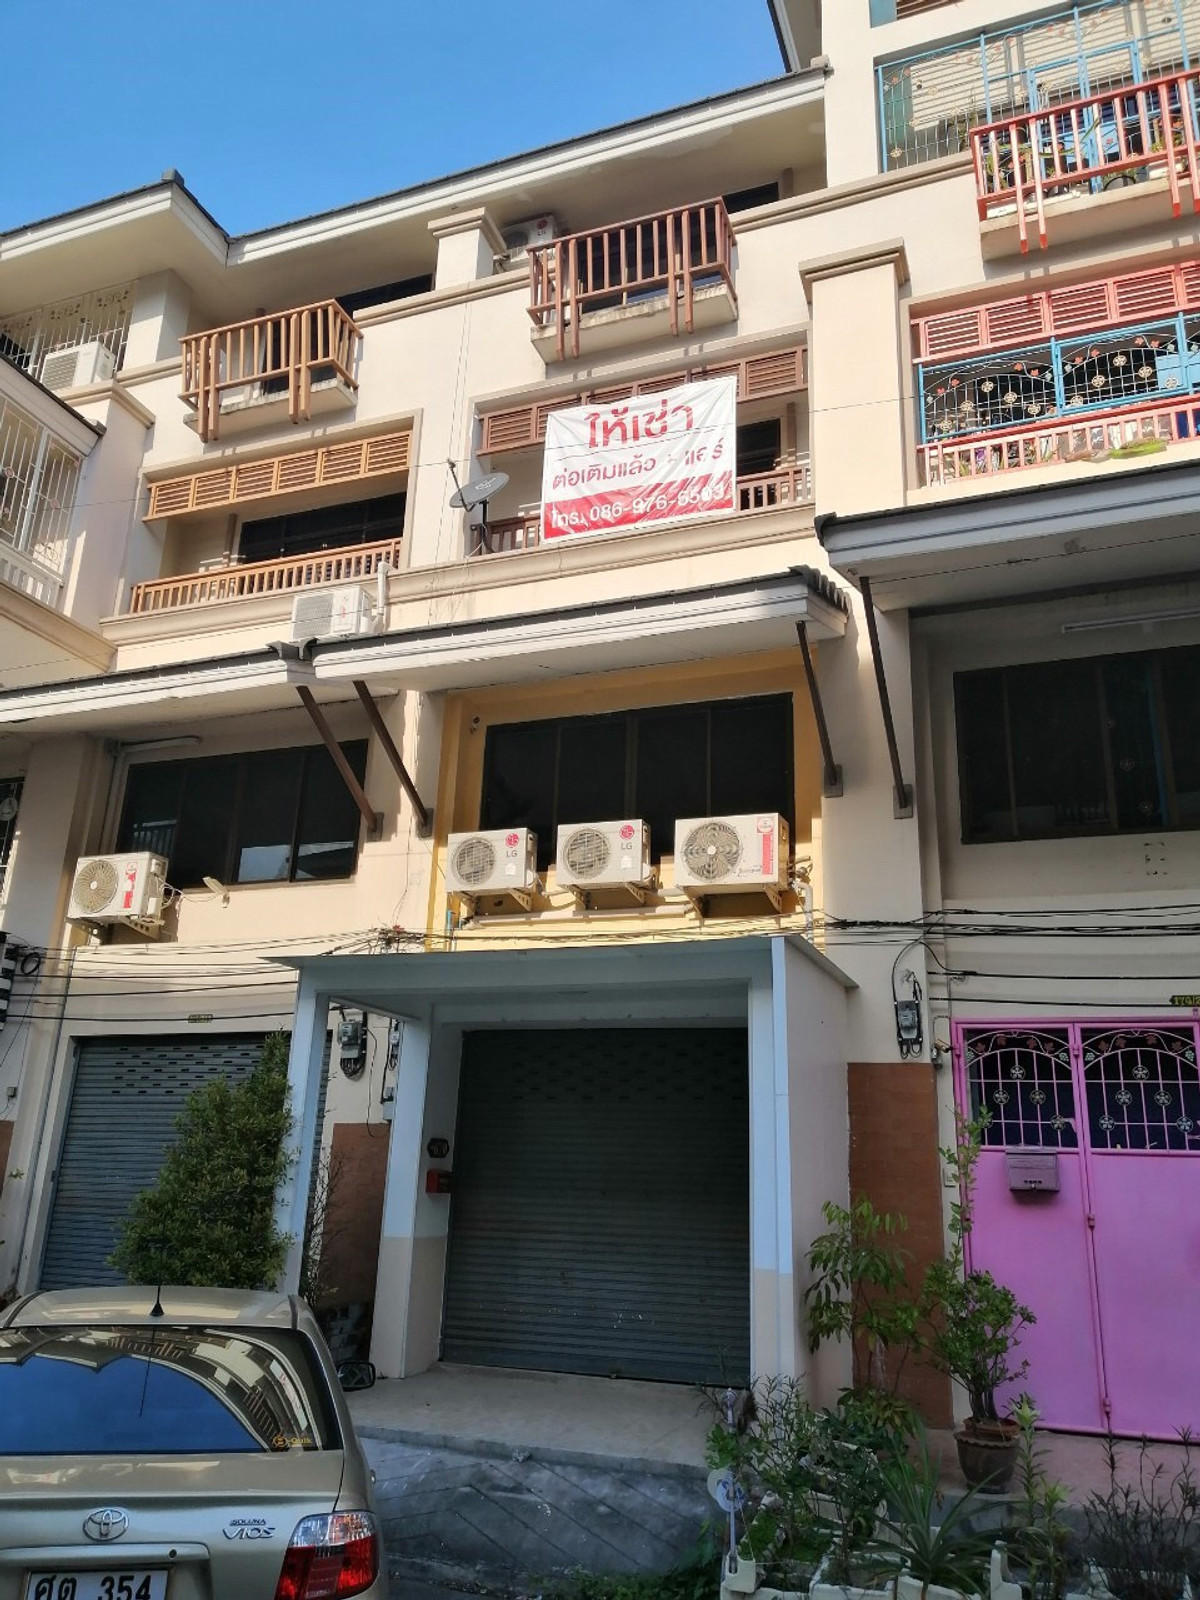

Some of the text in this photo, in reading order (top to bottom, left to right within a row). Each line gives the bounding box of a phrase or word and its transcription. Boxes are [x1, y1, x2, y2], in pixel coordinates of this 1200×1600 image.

[585, 399, 694, 449] ให้เช่า
[552, 453, 657, 490] ต่อเติมแล้ว
[506, 850, 518, 858] LG
[621, 842, 633, 850] LG
[222, 1527, 276, 1540] VIOS
[97, 1575, 152, 1600] 354
